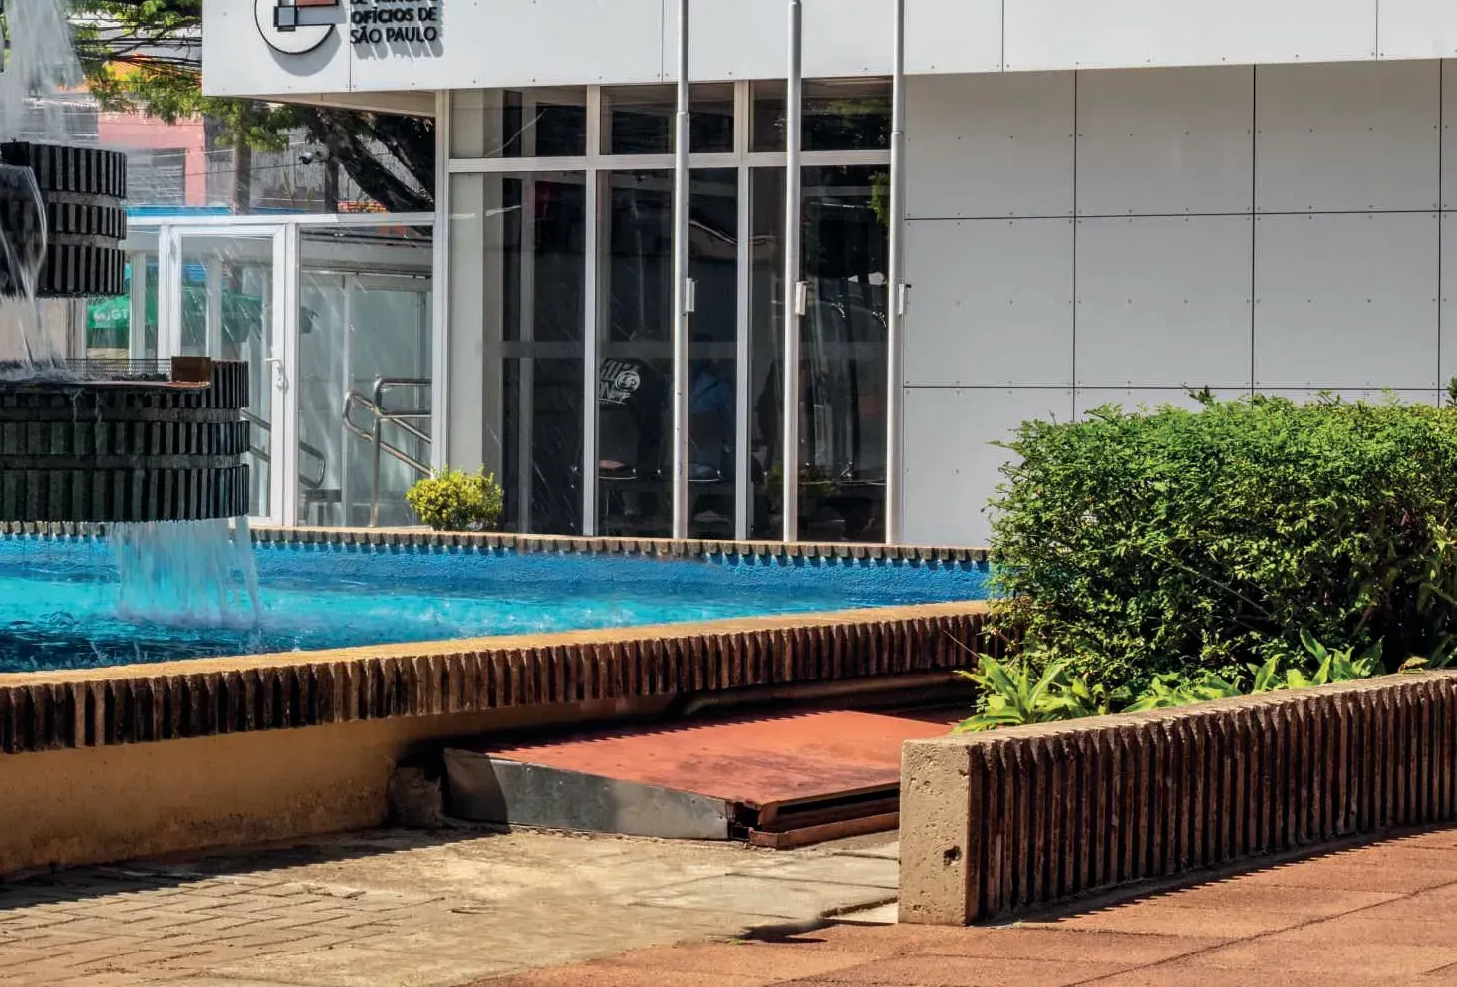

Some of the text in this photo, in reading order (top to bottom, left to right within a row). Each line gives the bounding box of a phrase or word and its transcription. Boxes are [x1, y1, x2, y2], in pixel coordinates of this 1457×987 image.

[351, 6, 437, 24] OFÍCIOS DE
[350, 25, 437, 44] SÃO PAULO
